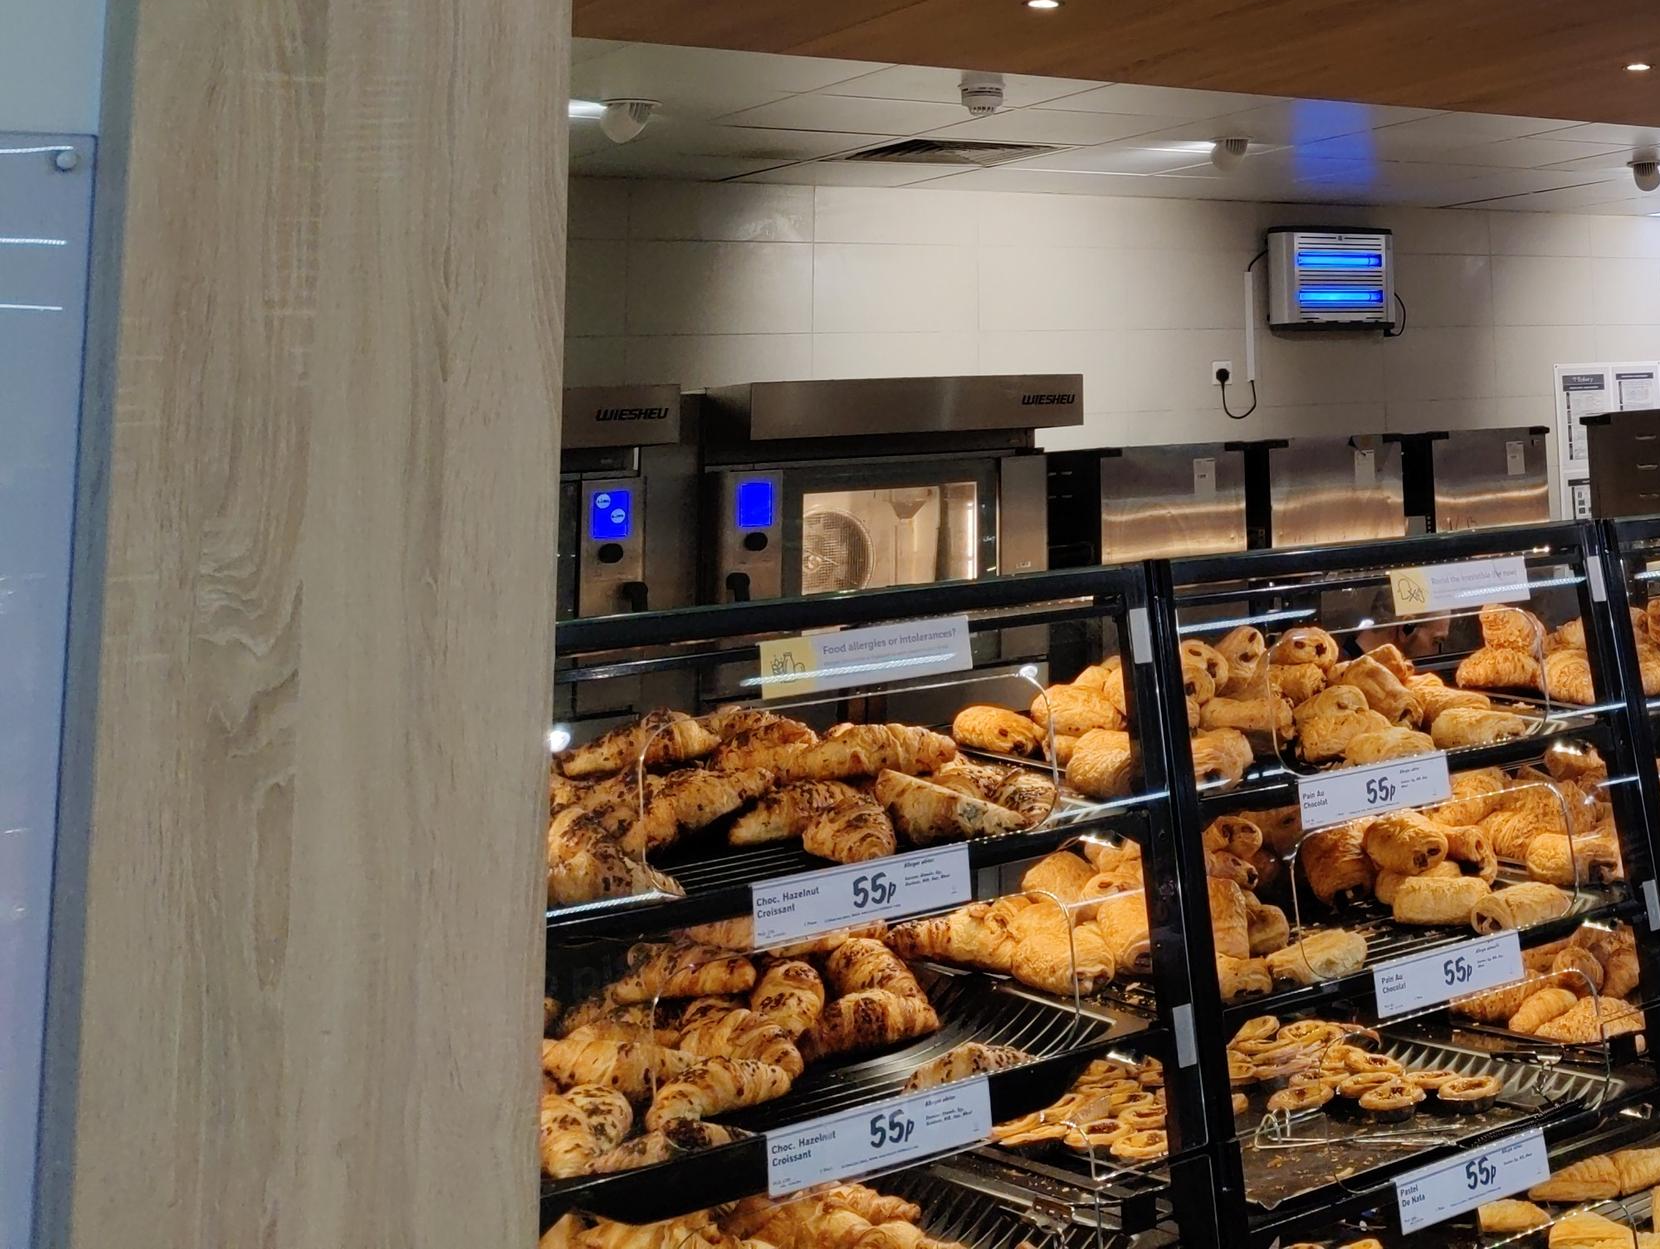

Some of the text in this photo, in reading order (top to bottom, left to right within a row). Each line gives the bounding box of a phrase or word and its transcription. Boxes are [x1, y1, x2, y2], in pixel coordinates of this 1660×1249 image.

[1022, 394, 1075, 405] WIESHEU
[596, 408, 669, 421] WIESHEU
[823, 628, 957, 655] Food allergies or intolerances?
[1366, 777, 1395, 804] 55p
[1304, 798, 1328, 809] Chocolat
[756, 886, 819, 907] Choc. Hazelnut
[852, 872, 896, 908] 55p
[757, 904, 795, 919] Croissant
[1443, 956, 1472, 985] 55p
[870, 1109, 914, 1148] 55p
[771, 1142, 796, 1154] Choc.
[772, 1150, 811, 1166] Croissant
[1465, 1156, 1496, 1190] 55p
